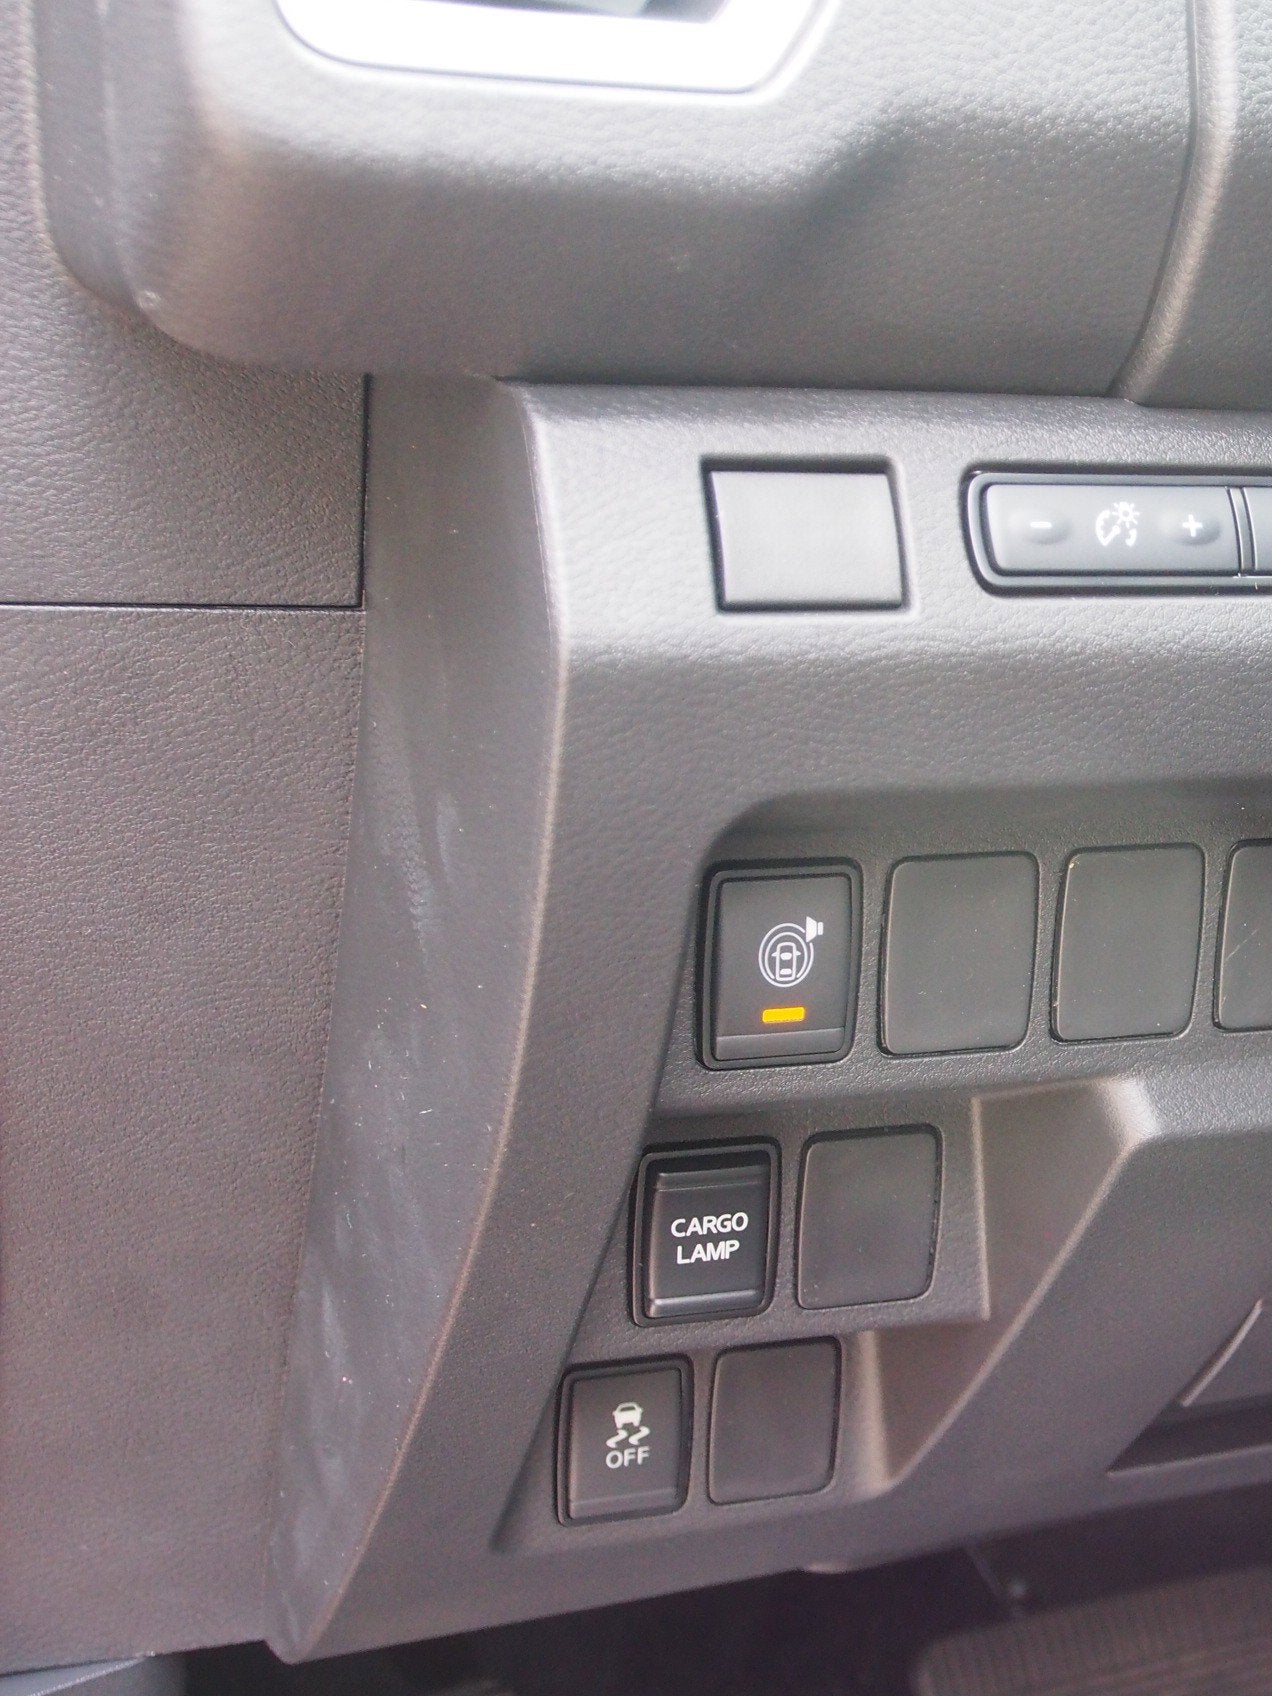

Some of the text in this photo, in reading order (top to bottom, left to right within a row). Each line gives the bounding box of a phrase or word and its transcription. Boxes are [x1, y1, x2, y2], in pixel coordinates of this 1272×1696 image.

[670, 1212, 748, 1238] CARGO
[676, 1239, 740, 1264] LAMP
[605, 1446, 650, 1469] OFF
